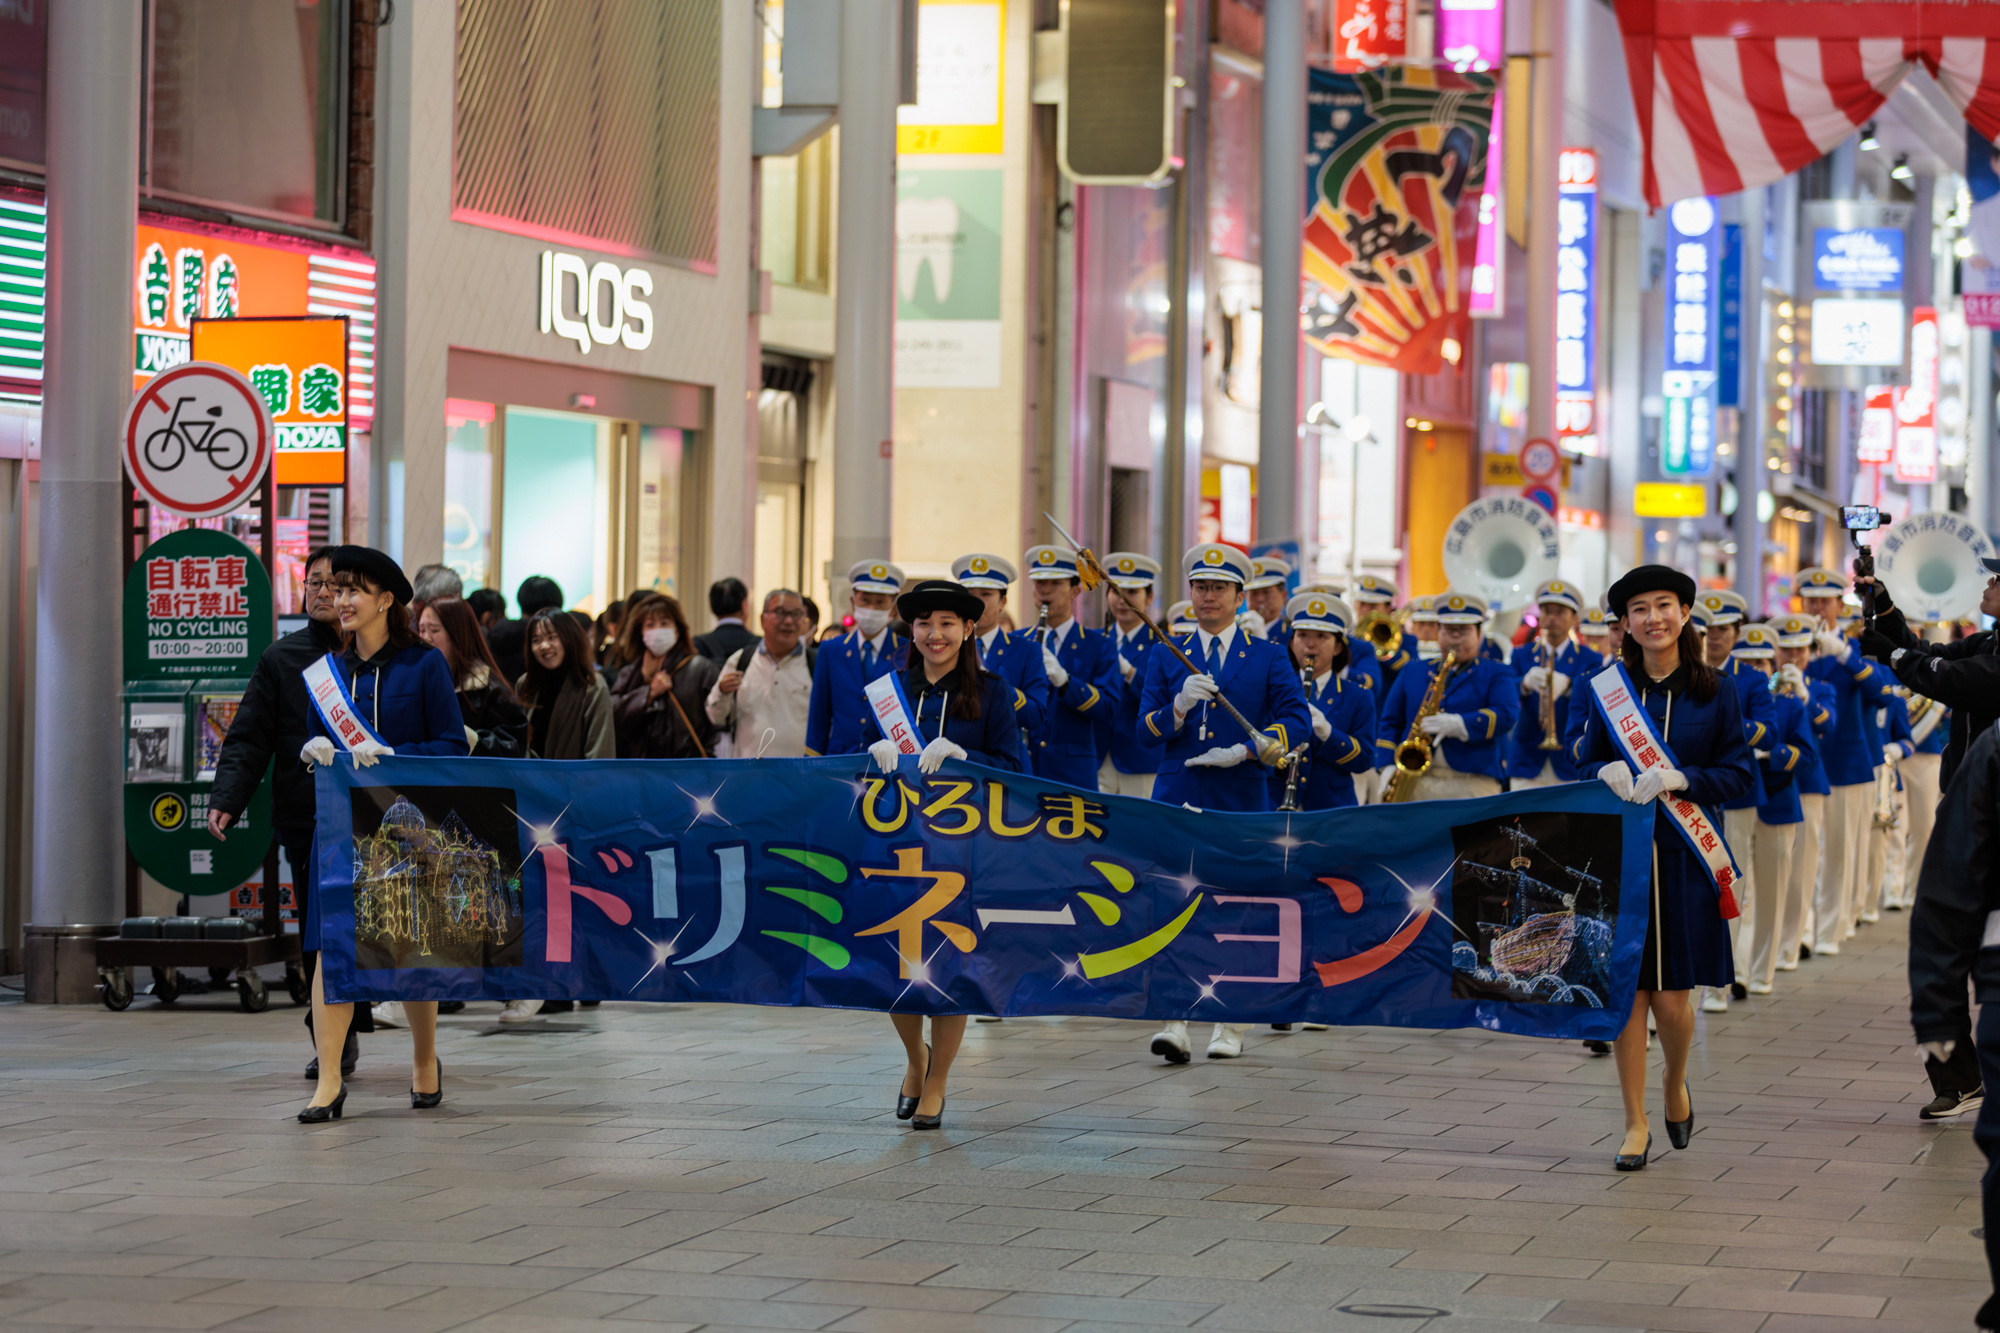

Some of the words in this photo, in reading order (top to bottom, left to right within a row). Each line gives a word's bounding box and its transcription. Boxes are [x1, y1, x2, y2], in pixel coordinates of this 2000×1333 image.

[914, 130, 942, 149] 2F
[139, 243, 239, 328] 吉野家
[540, 249, 654, 355] IQOS
[1446, 499, 1559, 559] 広島市消防音楽隊
[147, 556, 247, 591] 自転車
[148, 591, 248, 618] 通行禁止
[148, 622, 172, 637] NO
[176, 621, 248, 636] CYCLING
[860, 777, 1104, 840] ひろしま
[536, 842, 1437, 988] ドリミネーション
